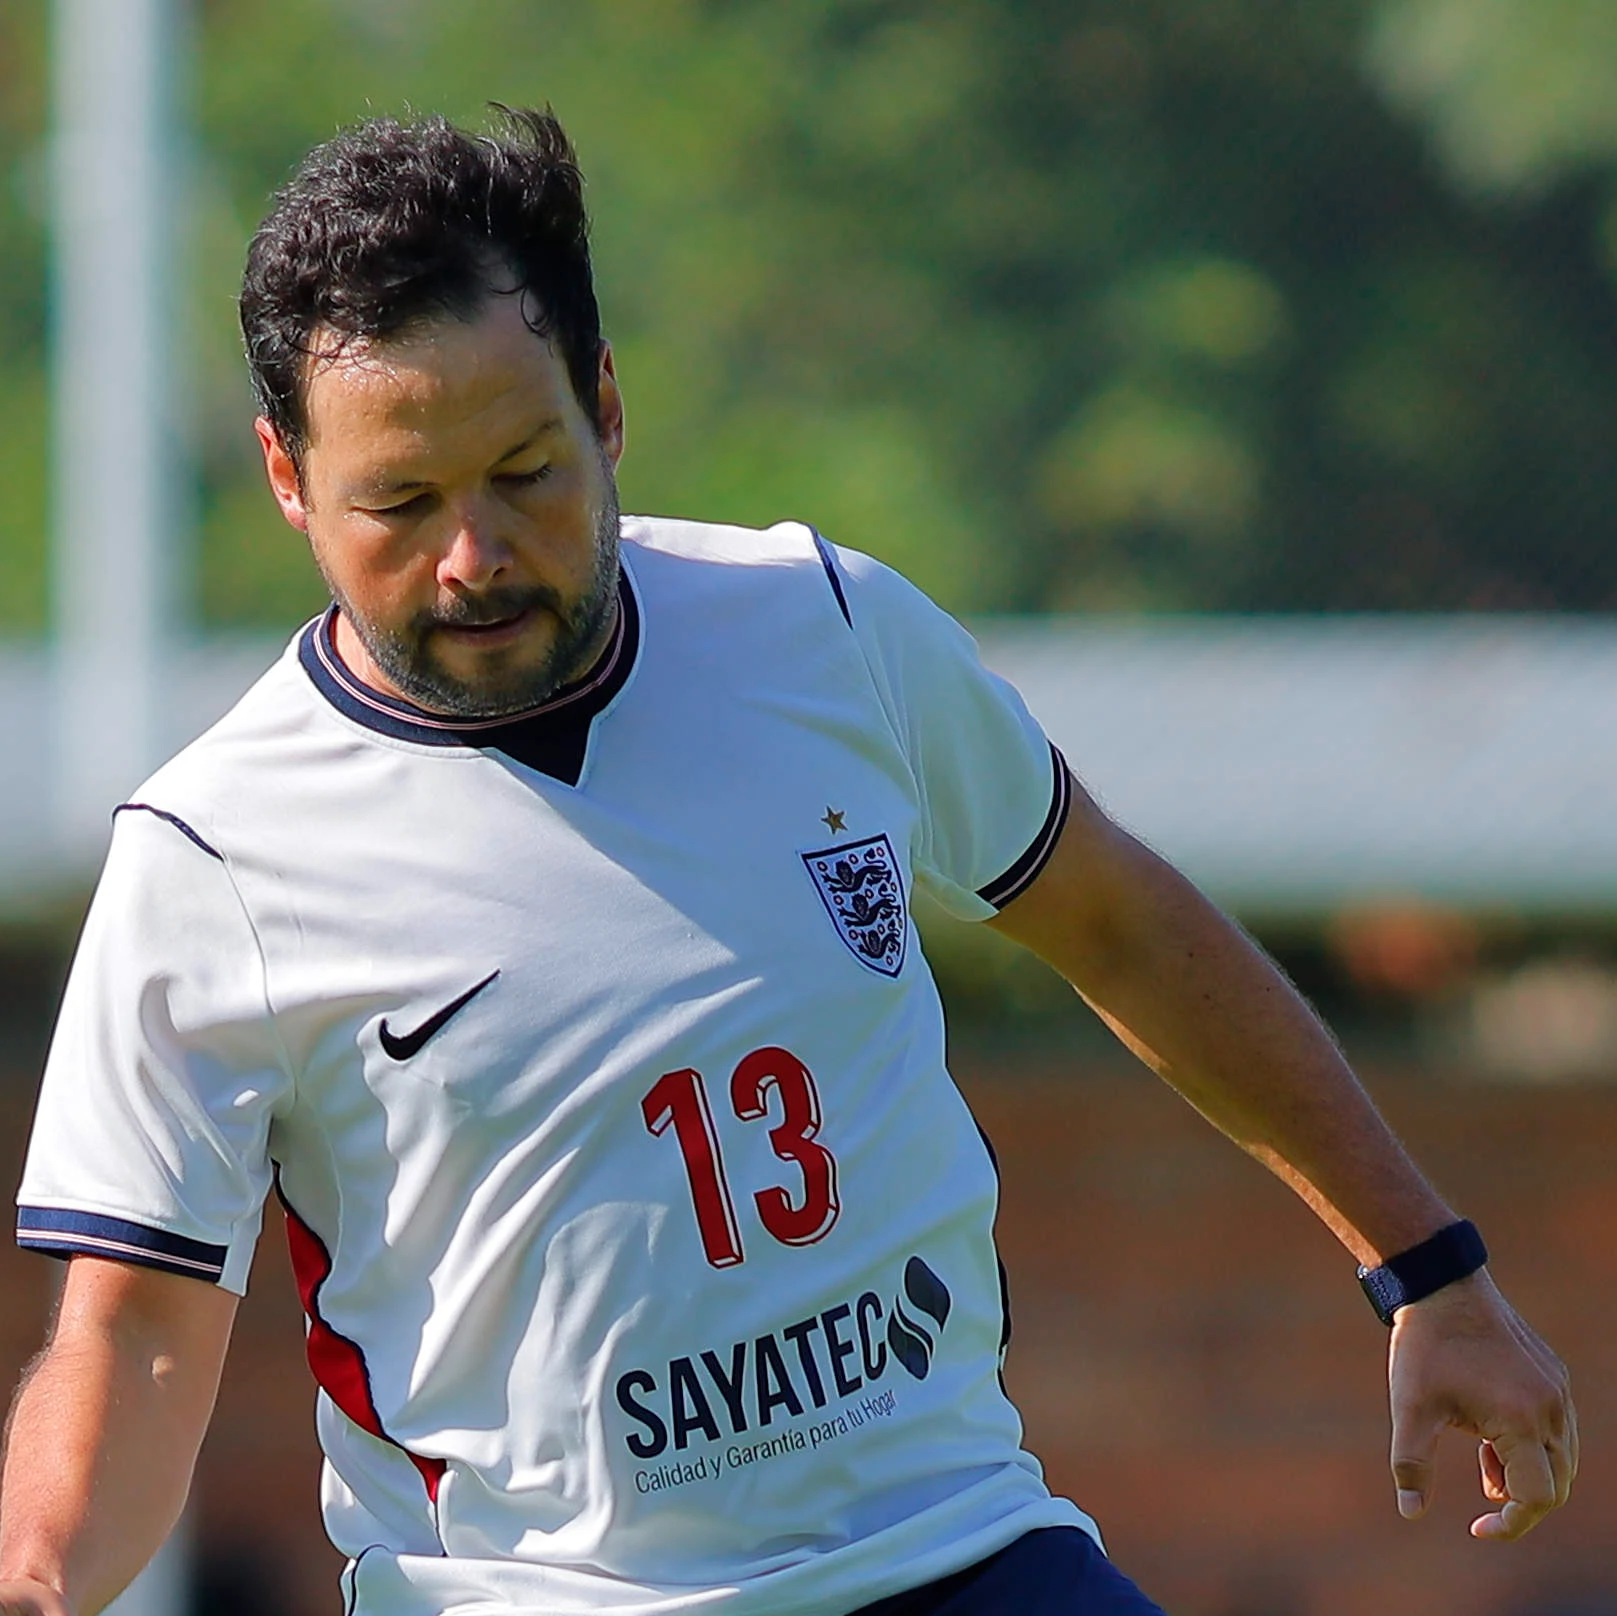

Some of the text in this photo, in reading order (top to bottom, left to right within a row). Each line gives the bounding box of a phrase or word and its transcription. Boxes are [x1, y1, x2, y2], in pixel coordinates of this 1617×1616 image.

[641, 1045, 840, 1268] 13
[615, 1291, 886, 1459] SAYATEC
[635, 1389, 896, 1494] Calidad y Garantía para tu Hogar
